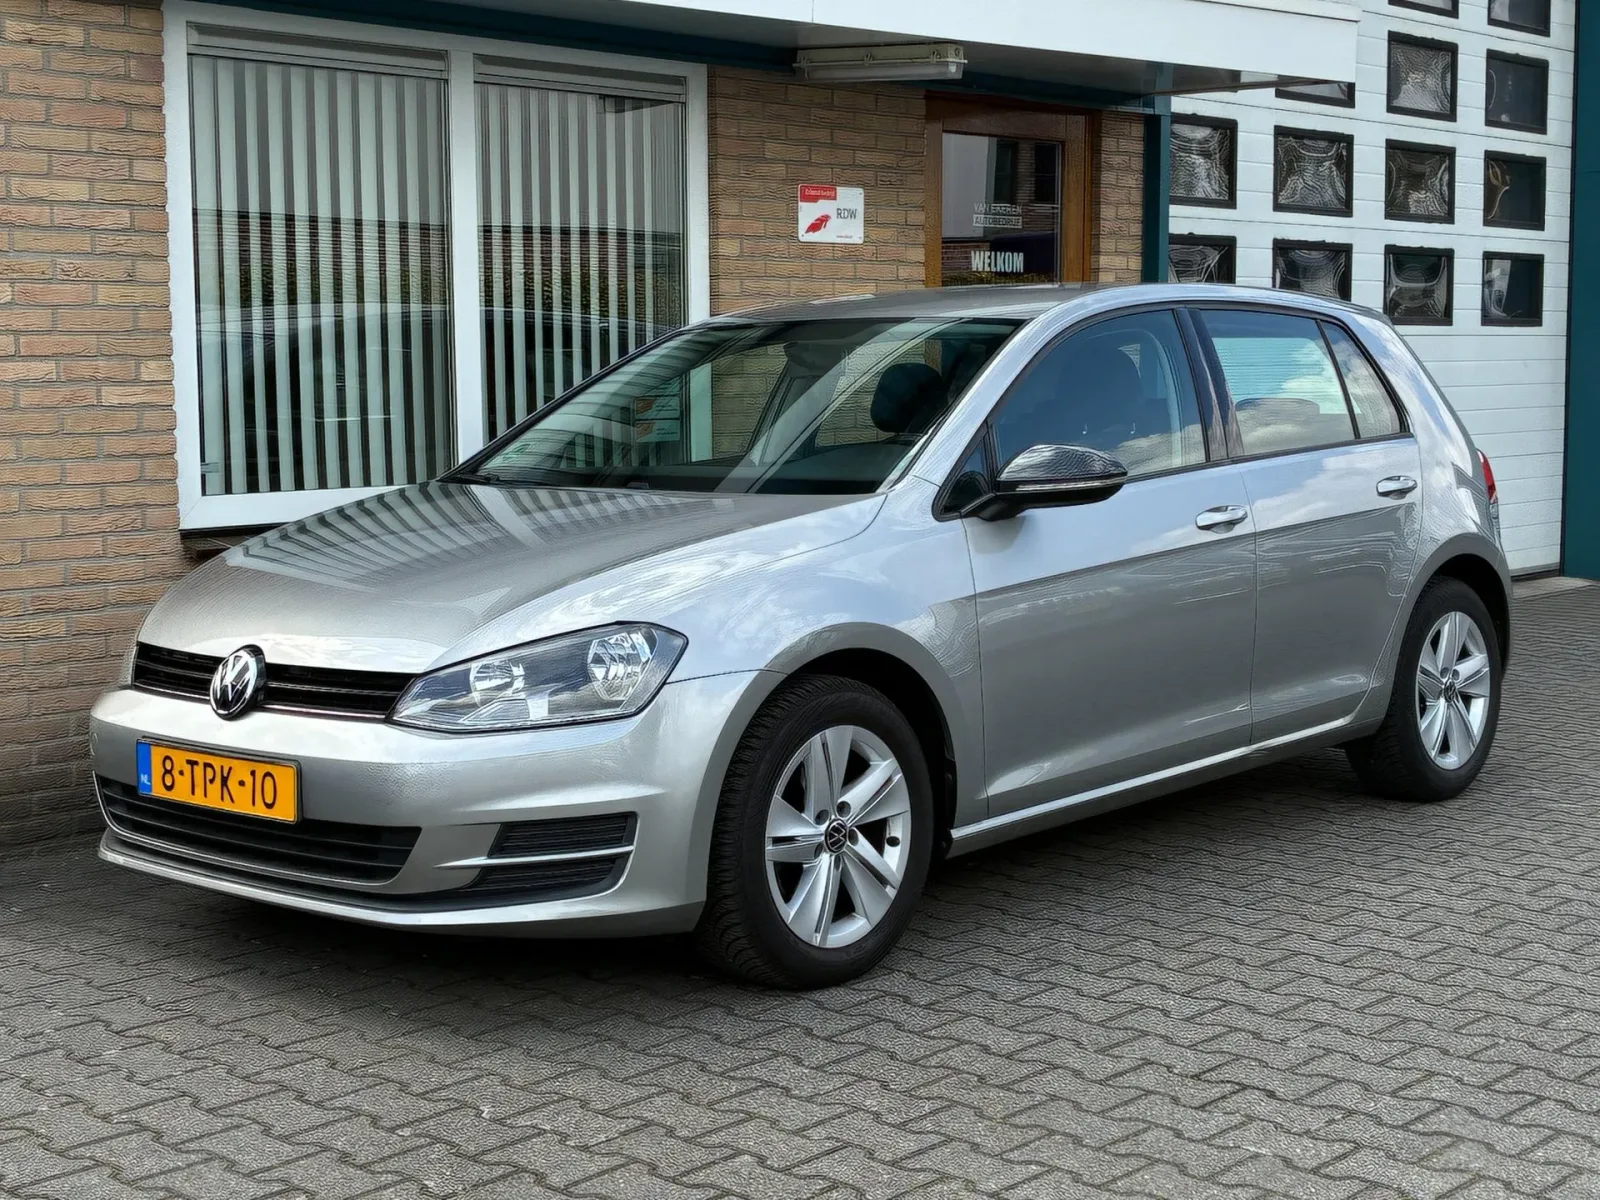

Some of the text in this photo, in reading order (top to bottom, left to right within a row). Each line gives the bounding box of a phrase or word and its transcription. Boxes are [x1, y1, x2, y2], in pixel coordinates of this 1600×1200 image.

[836, 208, 858, 220] RDW
[971, 250, 1024, 273] WELKOM
[140, 773, 151, 785] NL
[161, 754, 278, 810] 8-TPK-10
